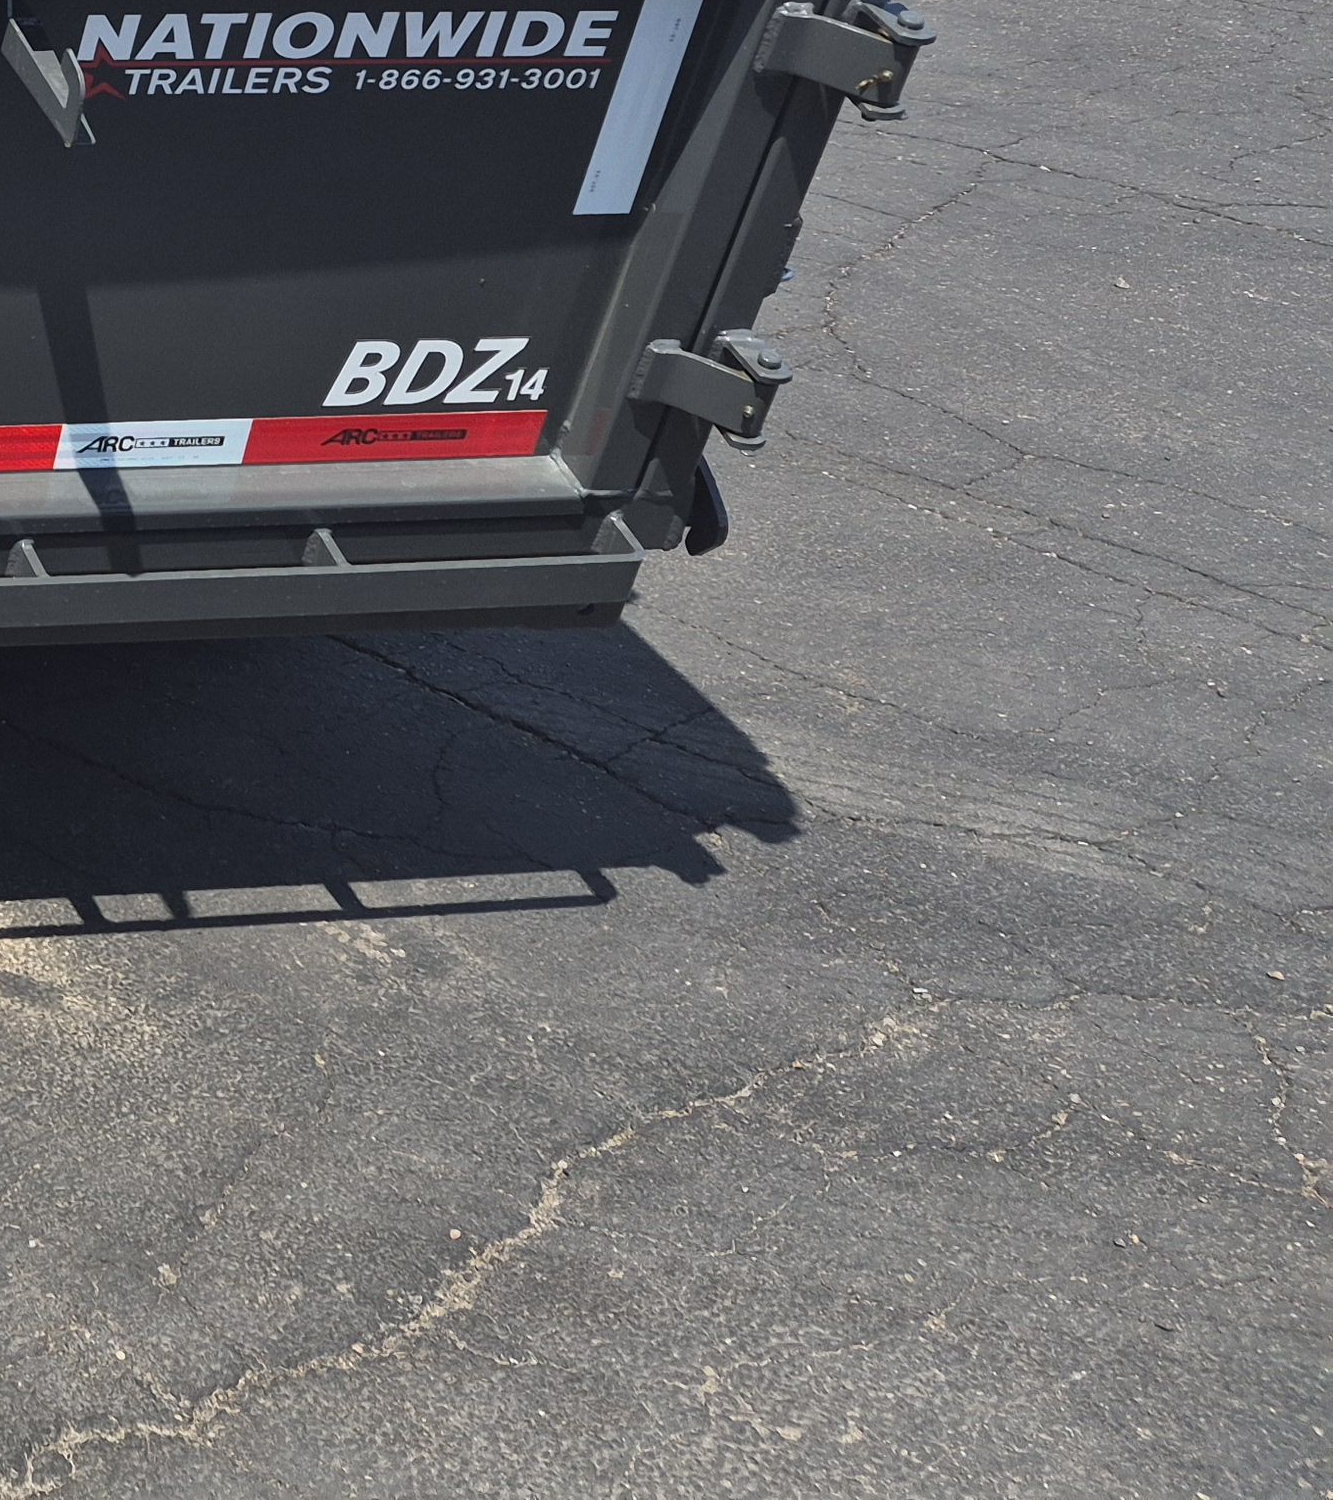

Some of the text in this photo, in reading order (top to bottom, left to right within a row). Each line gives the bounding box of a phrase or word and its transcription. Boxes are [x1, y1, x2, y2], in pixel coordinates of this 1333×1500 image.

[77, 9, 621, 61] NATIONWIDE
[124, 66, 602, 96] TRAILERS 1-866-931-3001
[321, 337, 550, 407] BDZ 14
[76, 436, 222, 453] ARC TRAILERS
[320, 428, 379, 446] ARC
